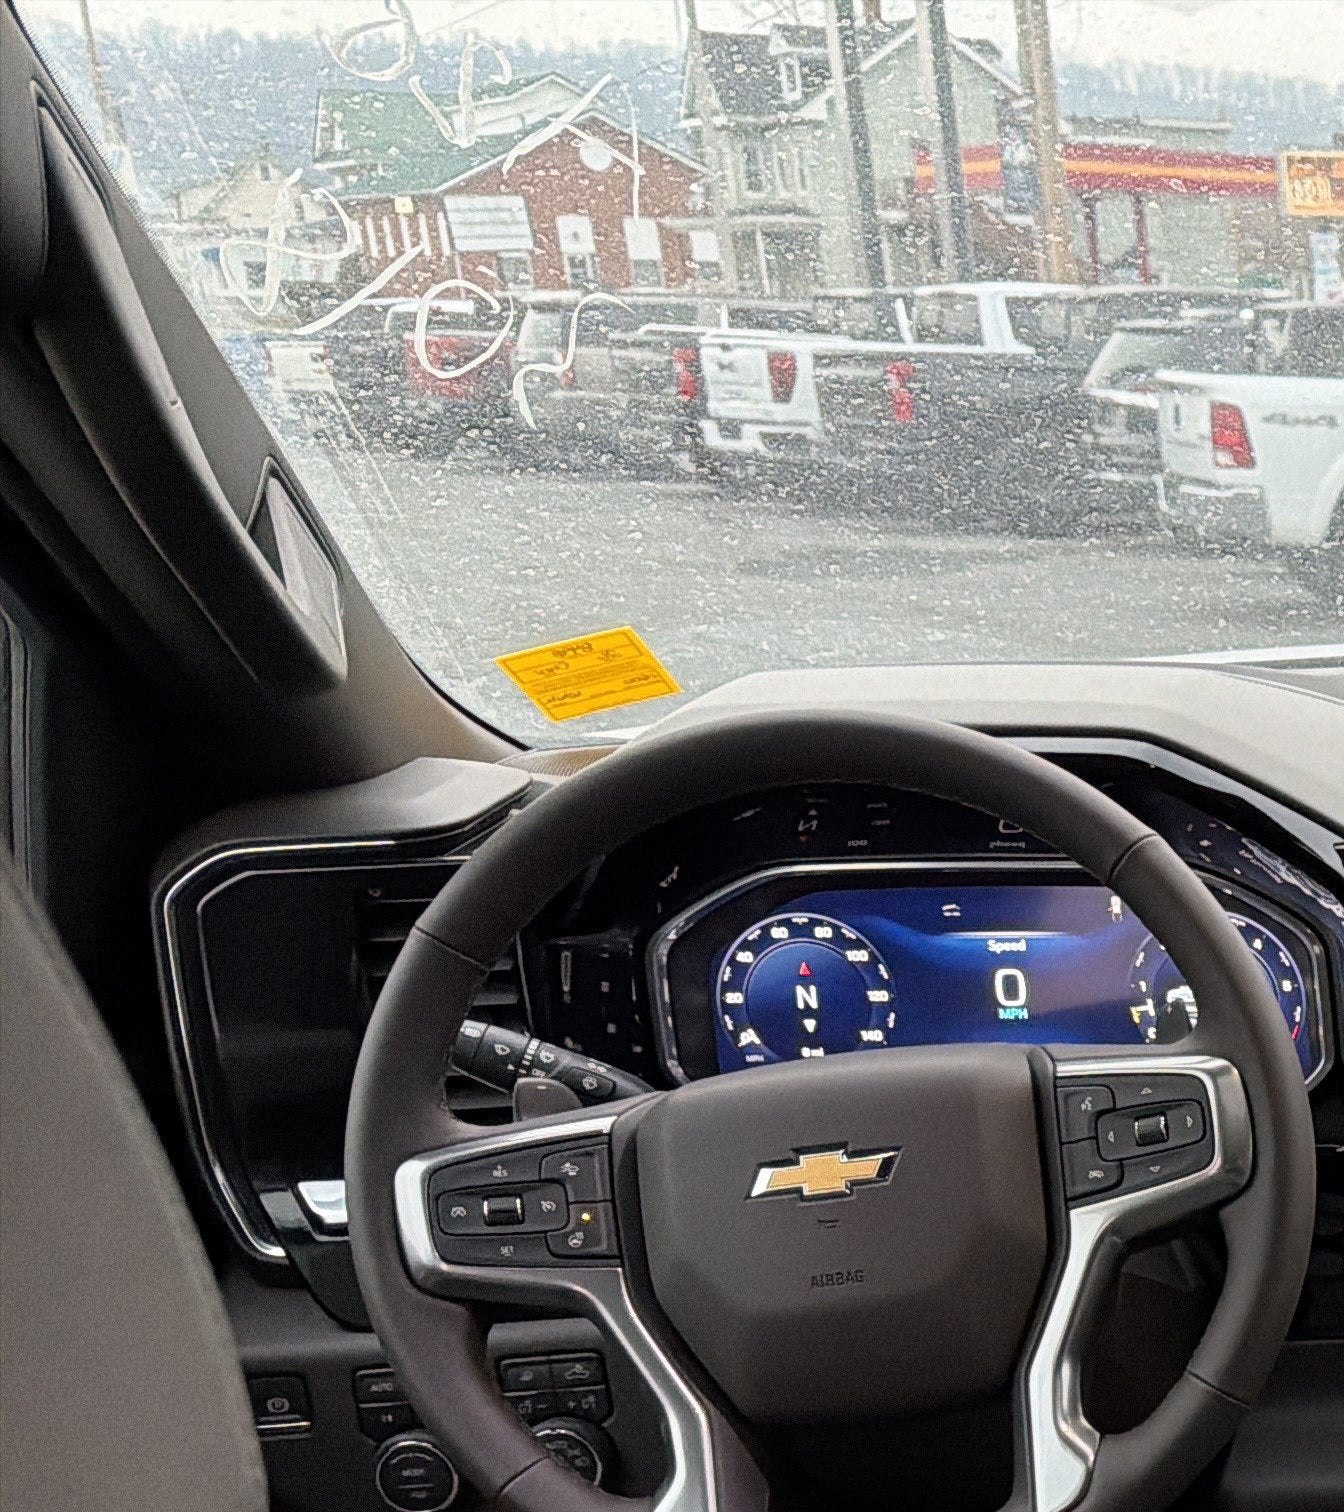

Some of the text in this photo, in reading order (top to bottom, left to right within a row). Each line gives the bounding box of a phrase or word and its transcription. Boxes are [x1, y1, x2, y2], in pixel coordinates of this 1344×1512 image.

[986, 939, 1028, 954] Speed
[795, 984, 819, 1010] N
[994, 968, 1027, 1007] 0
[998, 1008, 1029, 1020] MPH
[811, 1269, 865, 1288] AIRBAG
